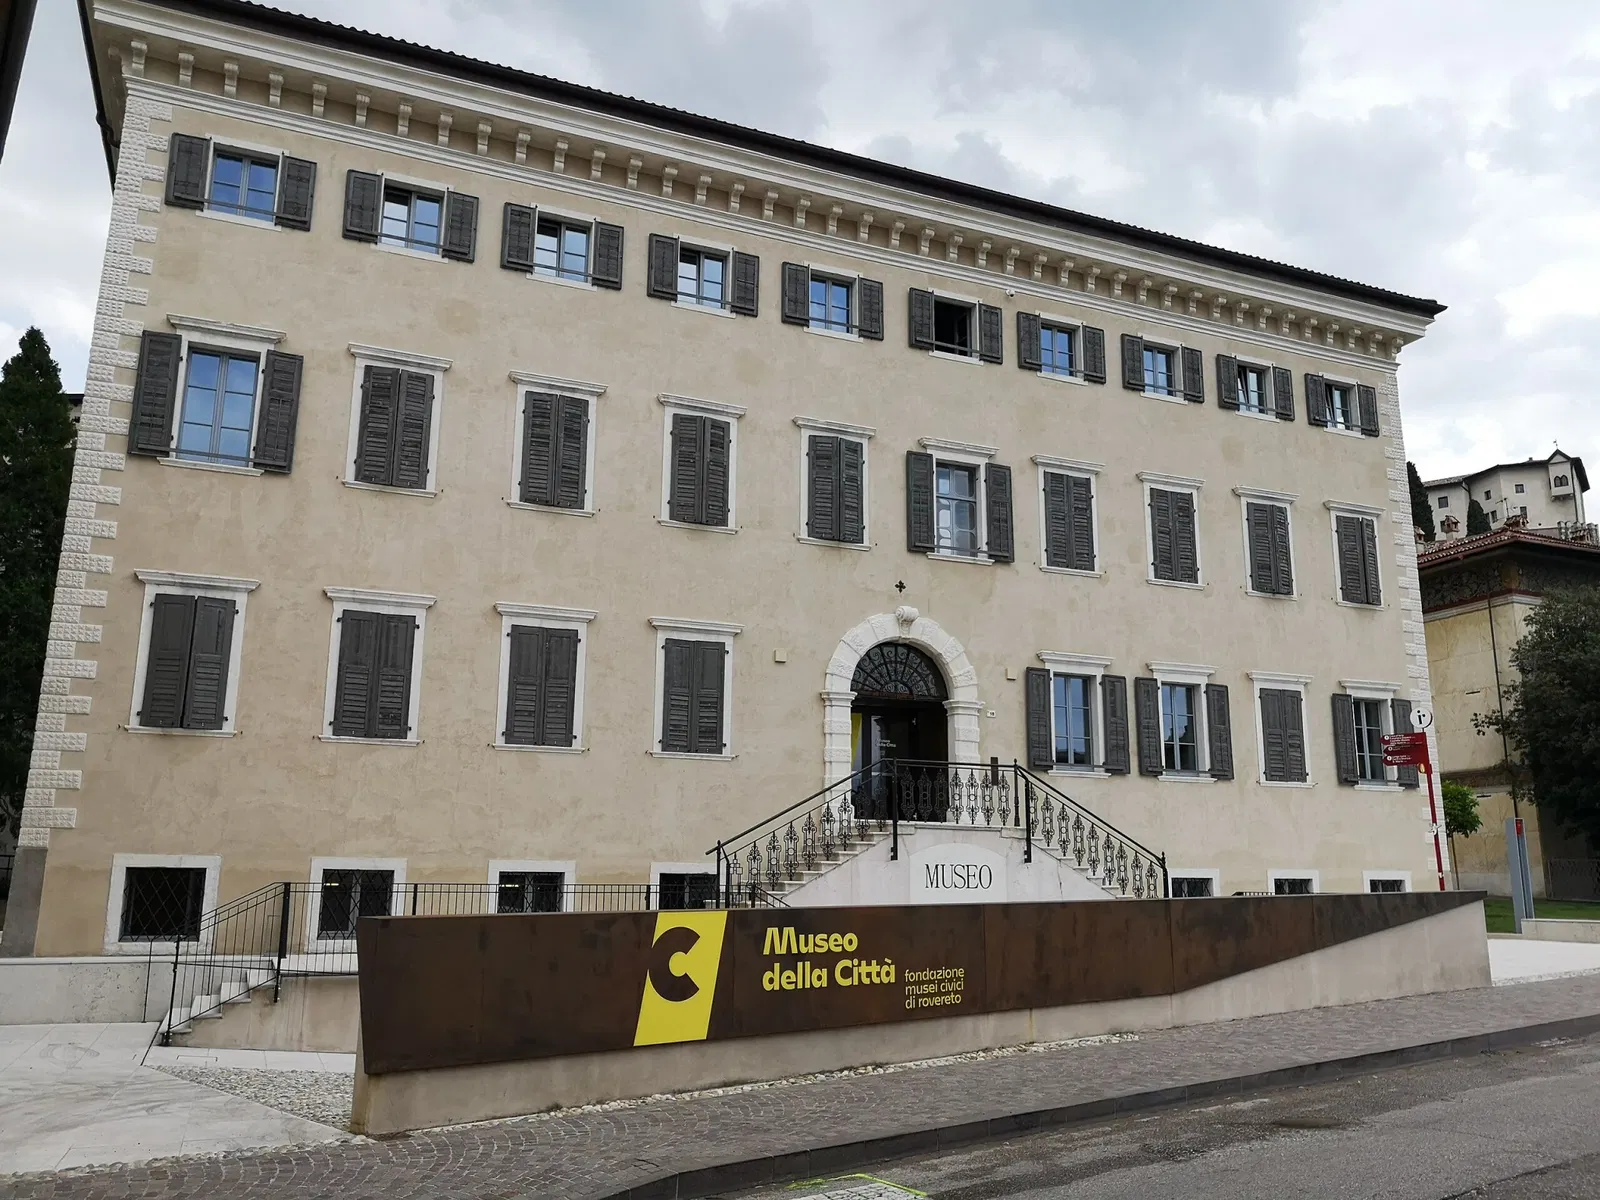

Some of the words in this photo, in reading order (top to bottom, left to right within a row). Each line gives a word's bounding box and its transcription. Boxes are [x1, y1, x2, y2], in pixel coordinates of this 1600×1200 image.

[924, 863, 993, 889] MUSEO
[763, 926, 858, 955] Museo
[762, 962, 828, 991] della
[834, 957, 896, 987] Città
[904, 966, 965, 983] fondazione
[905, 980, 938, 996] musei
[940, 977, 964, 992] civici
[905, 995, 916, 1009] di
[918, 992, 962, 1008] rovereto
